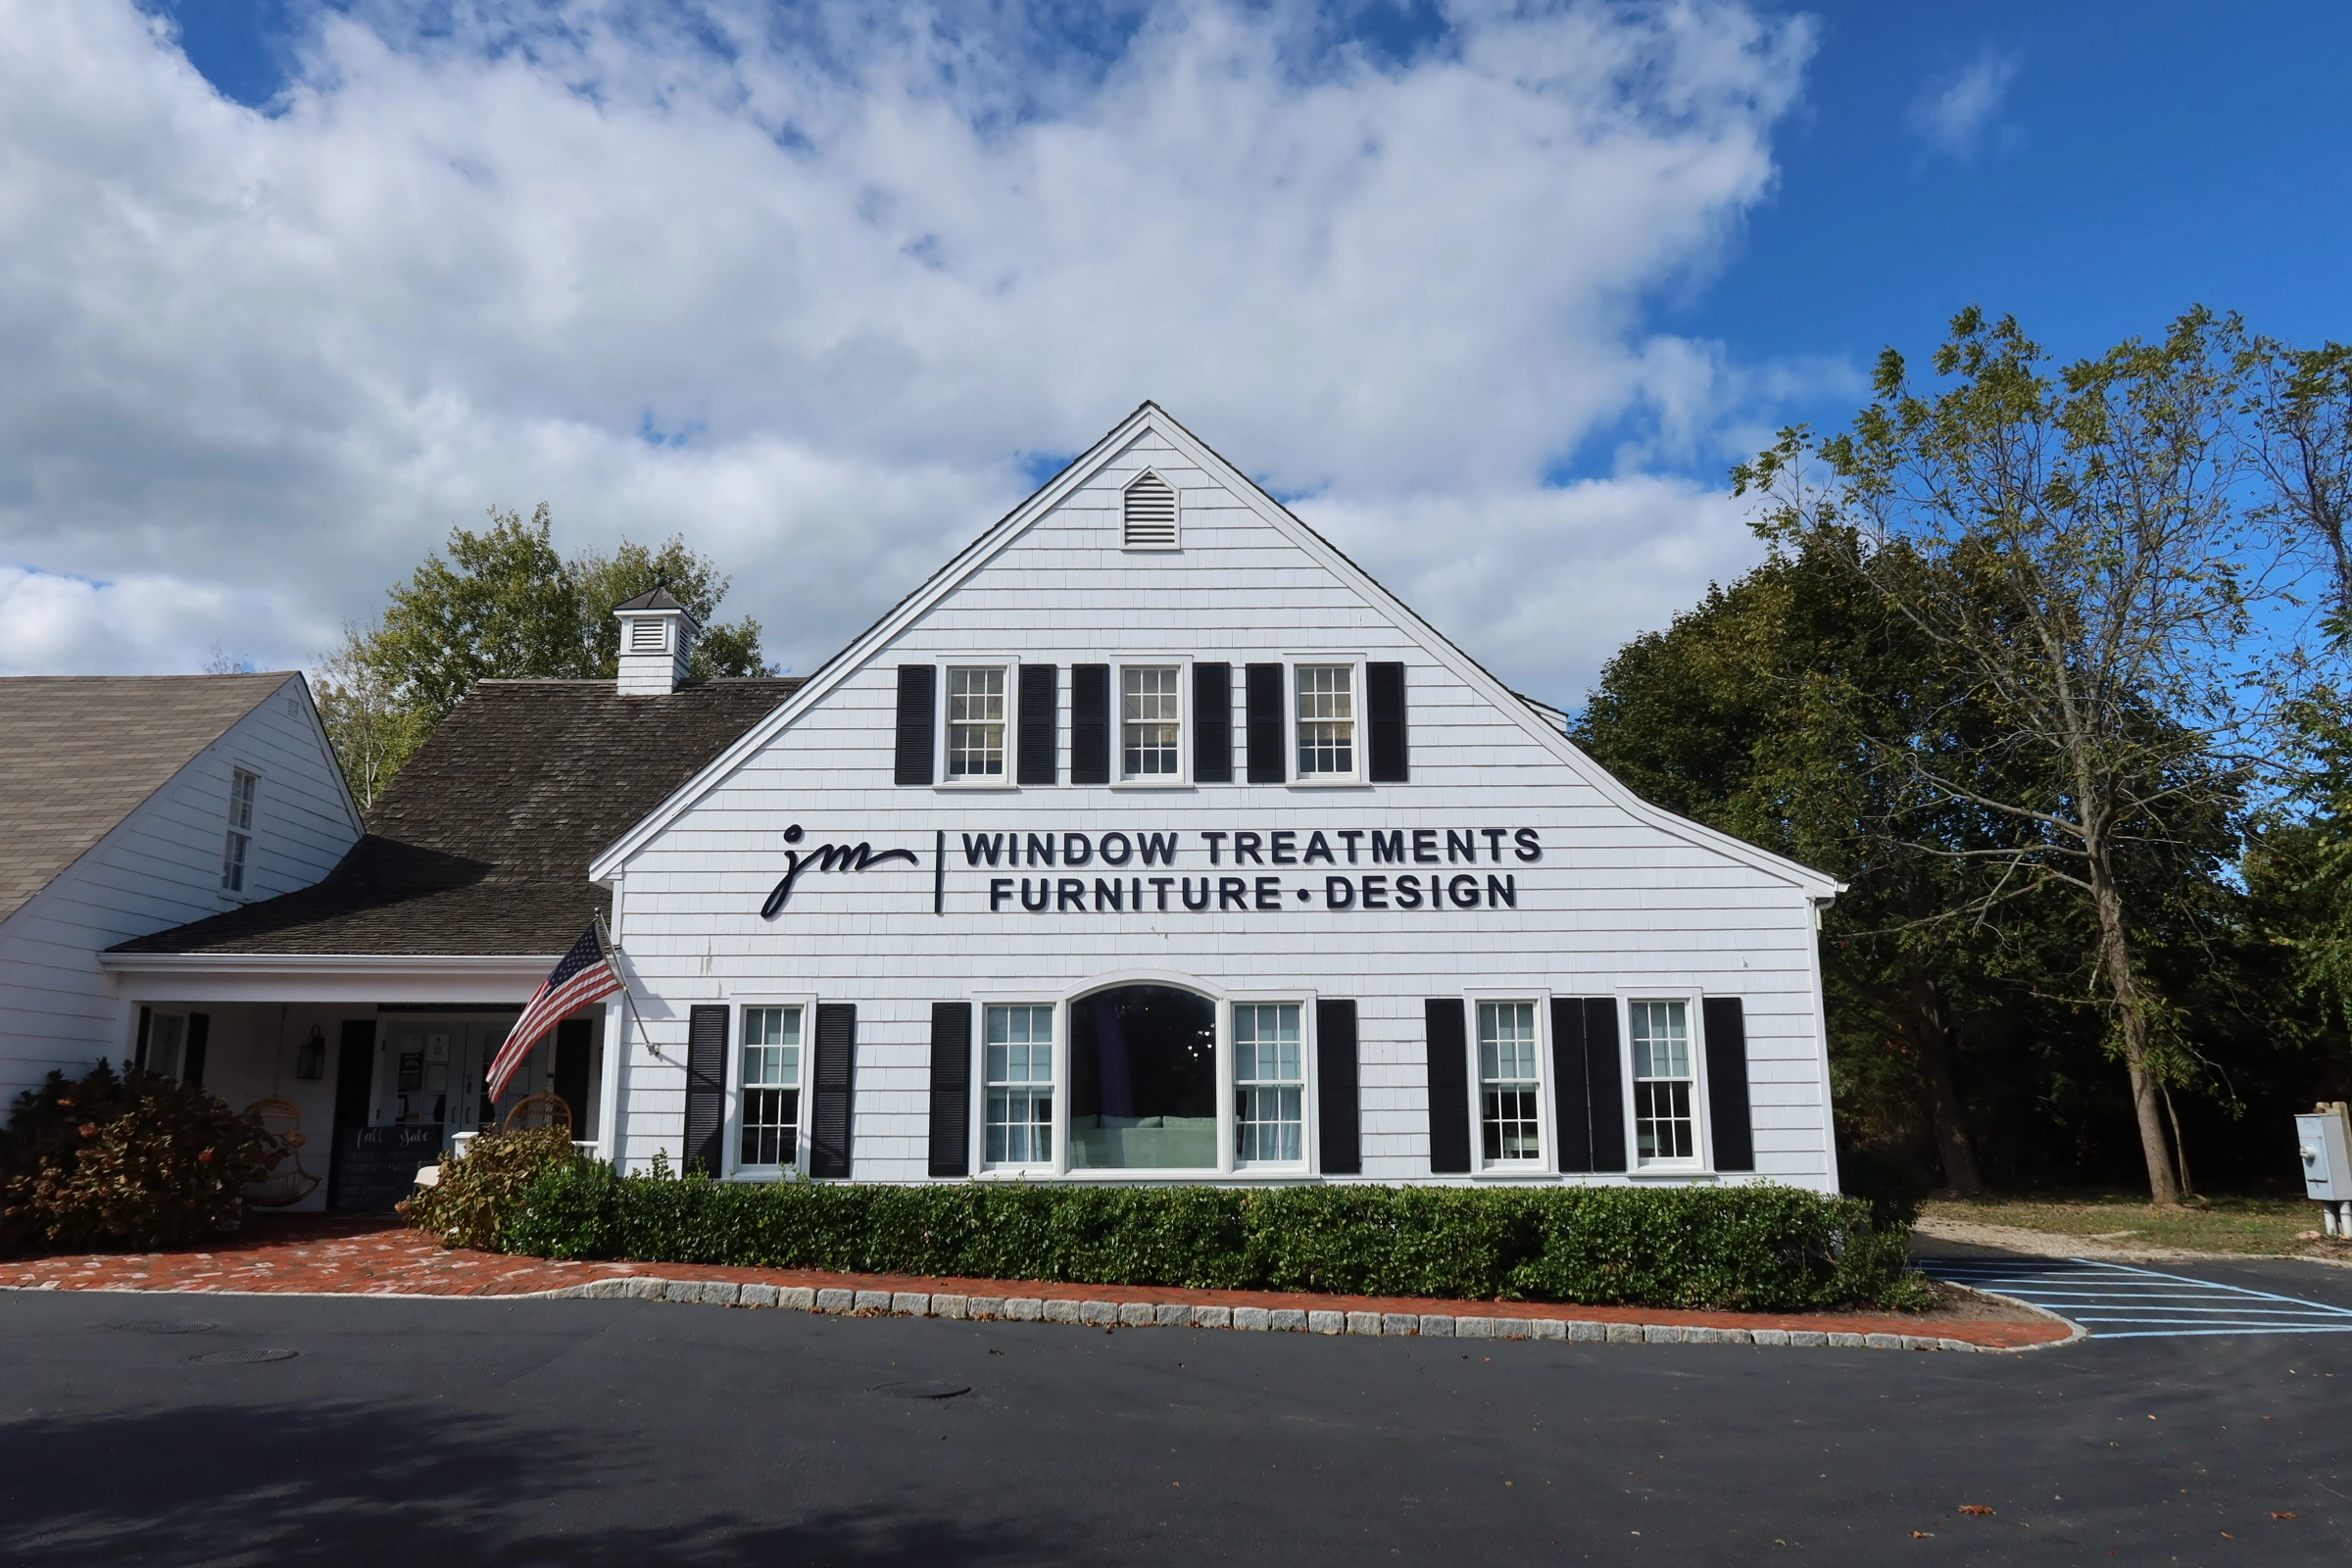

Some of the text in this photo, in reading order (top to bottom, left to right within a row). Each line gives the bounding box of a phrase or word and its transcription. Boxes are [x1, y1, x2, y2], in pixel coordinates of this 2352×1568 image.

[961, 827, 1542, 865] WINDOW TREATMENTS
[760, 823, 917, 919] jm
[990, 874, 1515, 911] FURNITURE DESIGN
